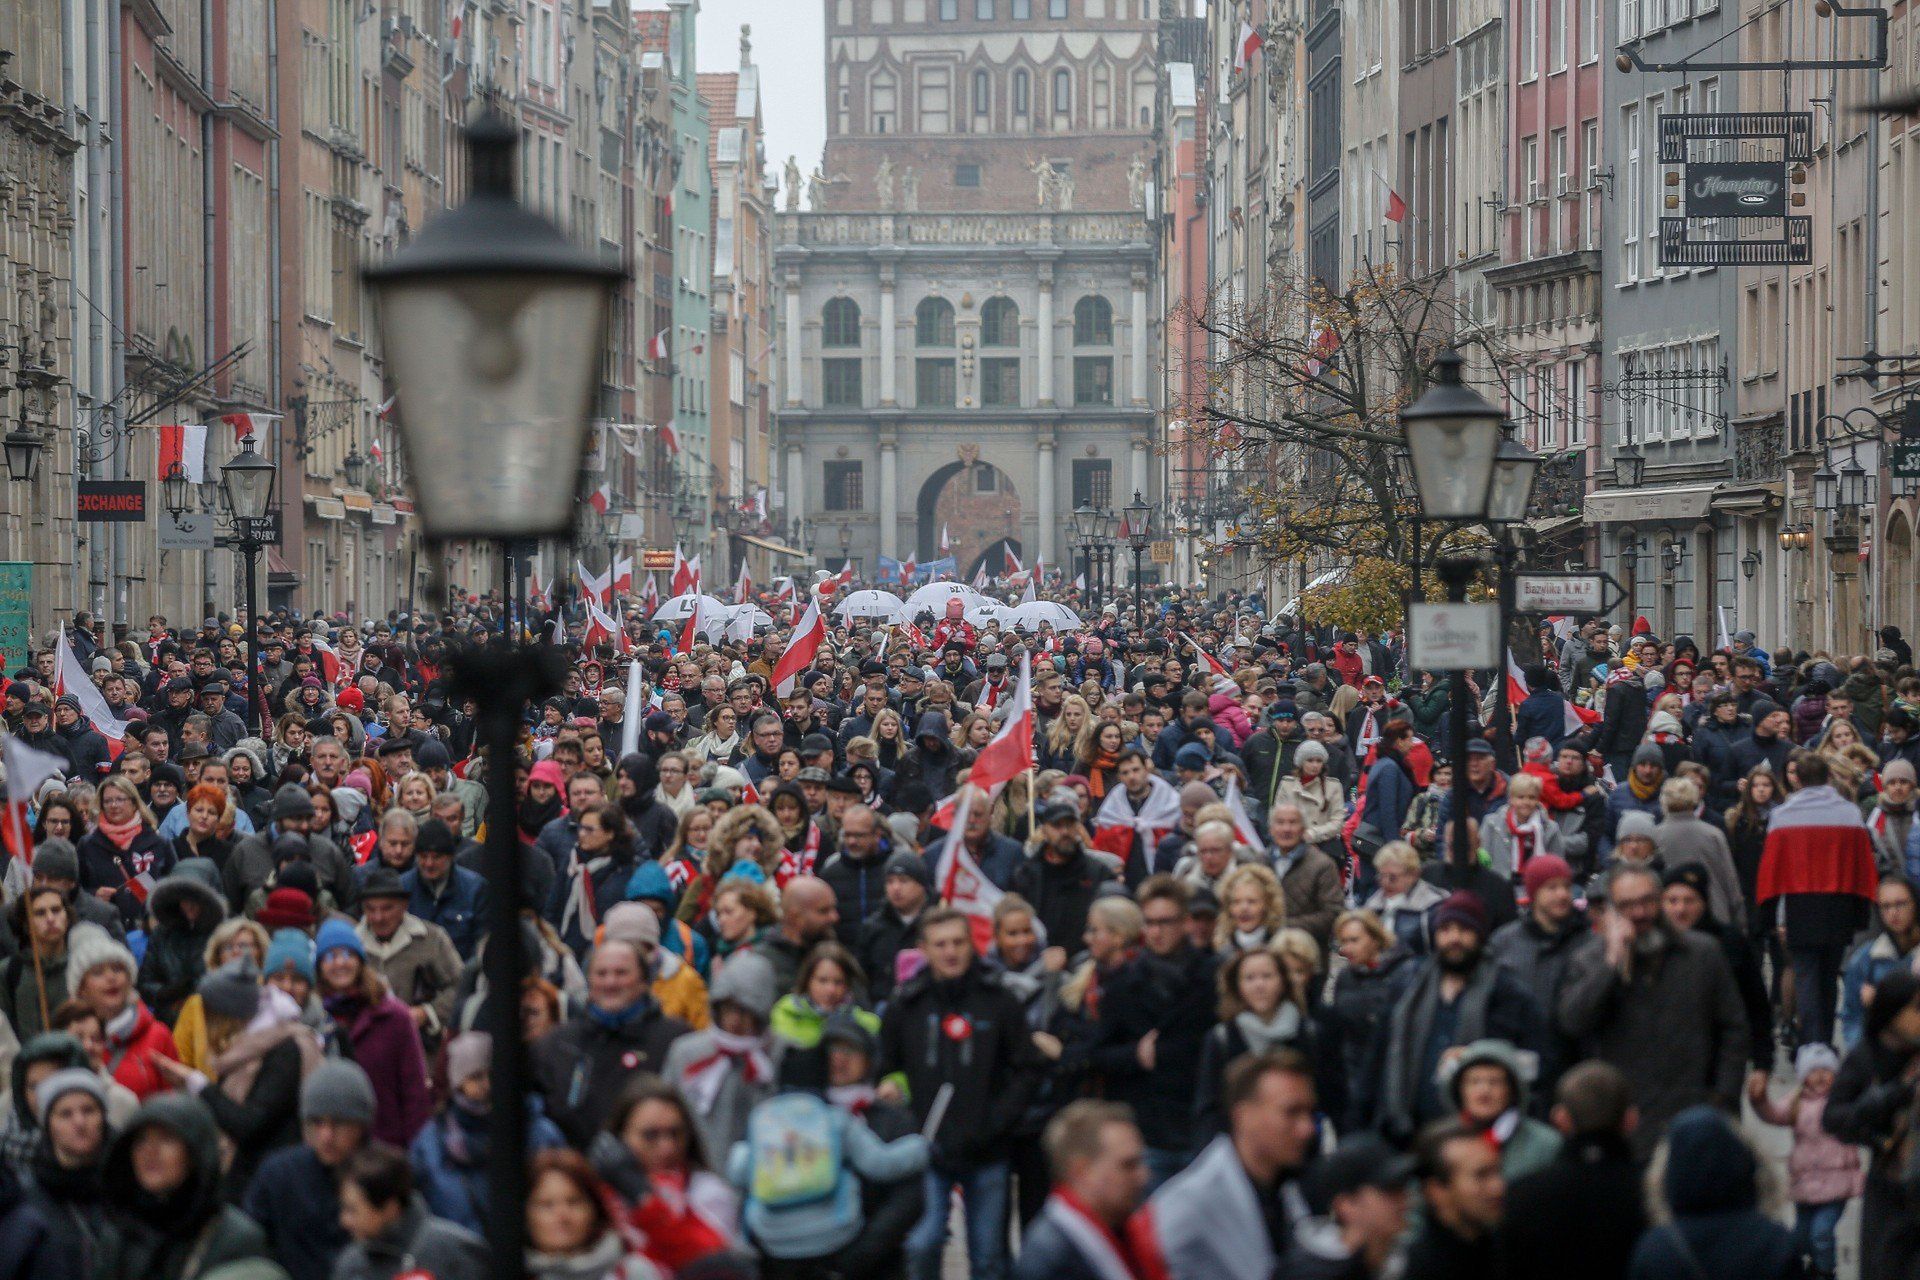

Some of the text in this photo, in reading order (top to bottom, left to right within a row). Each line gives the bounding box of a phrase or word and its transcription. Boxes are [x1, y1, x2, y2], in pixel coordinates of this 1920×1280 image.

[1694, 176, 1778, 198] Hampton
[78, 494, 143, 511] EXCHANGE
[1525, 582, 1561, 597] Bazylika
